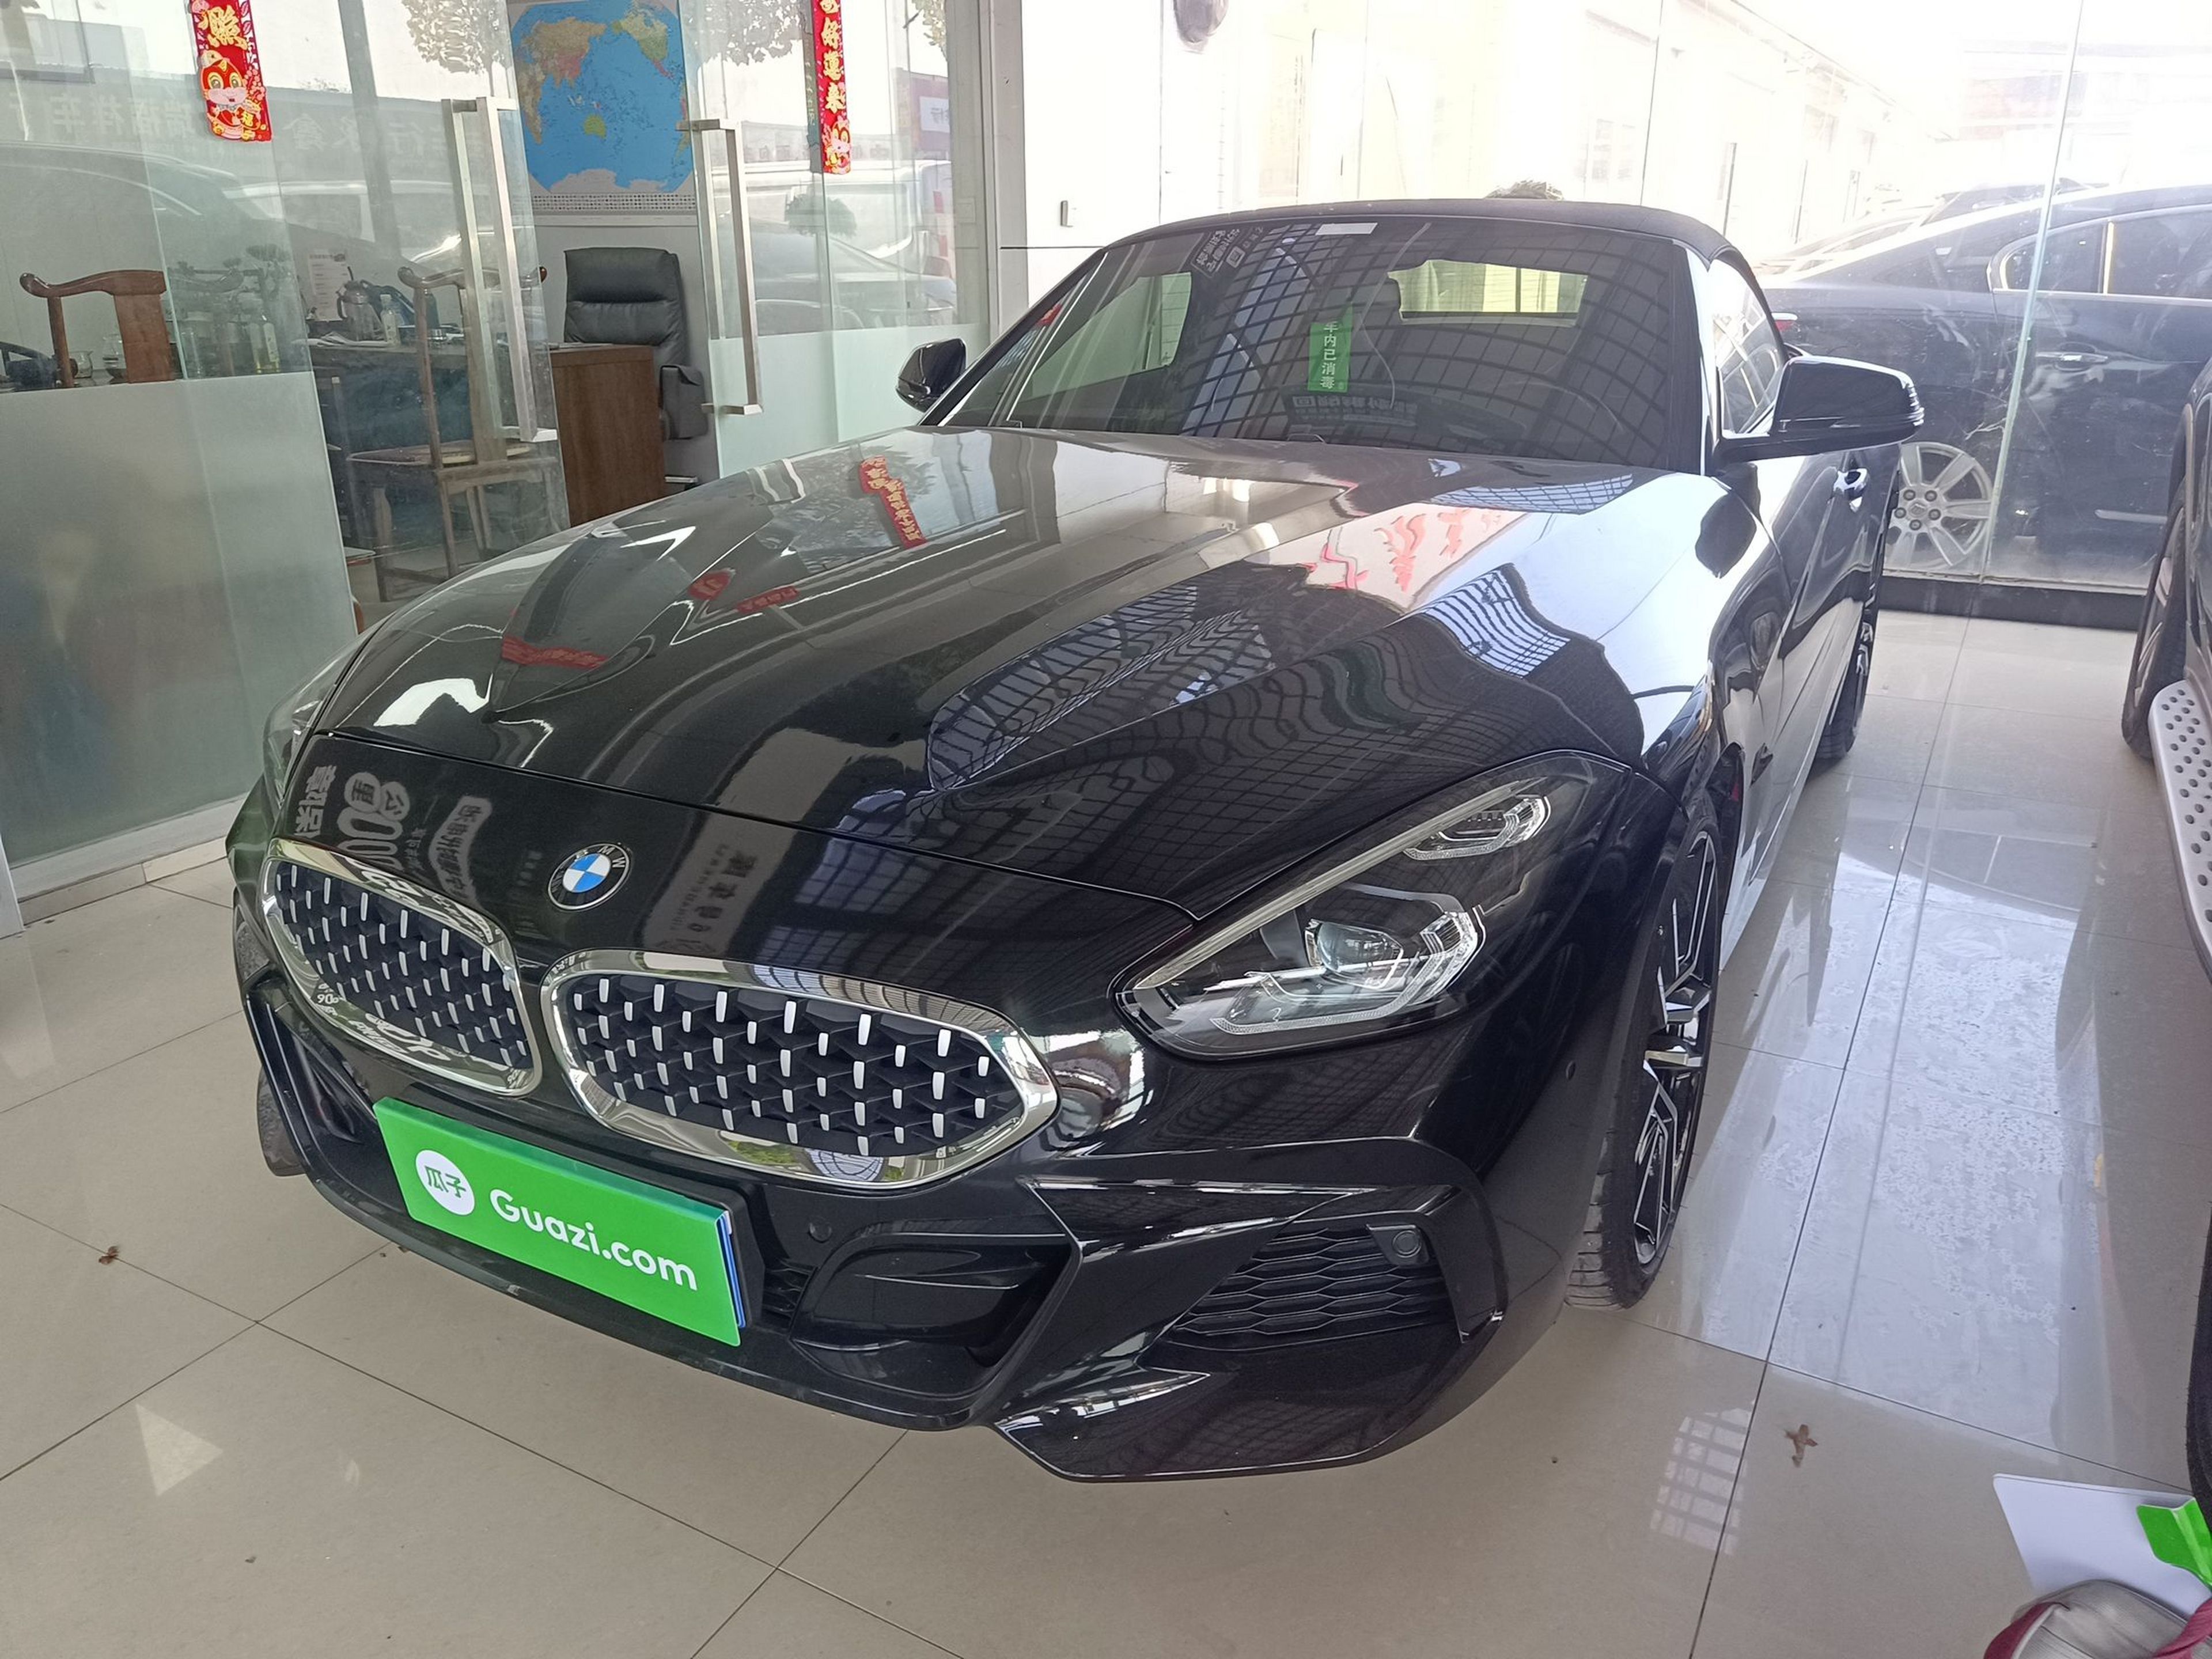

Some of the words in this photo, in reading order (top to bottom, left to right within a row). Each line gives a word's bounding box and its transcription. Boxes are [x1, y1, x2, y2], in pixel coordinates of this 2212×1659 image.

[1320, 320, 1339, 389] 车内已消毒
[425, 1165, 466, 1198] 瓜子
[490, 1188, 698, 1291] Guazi.com
